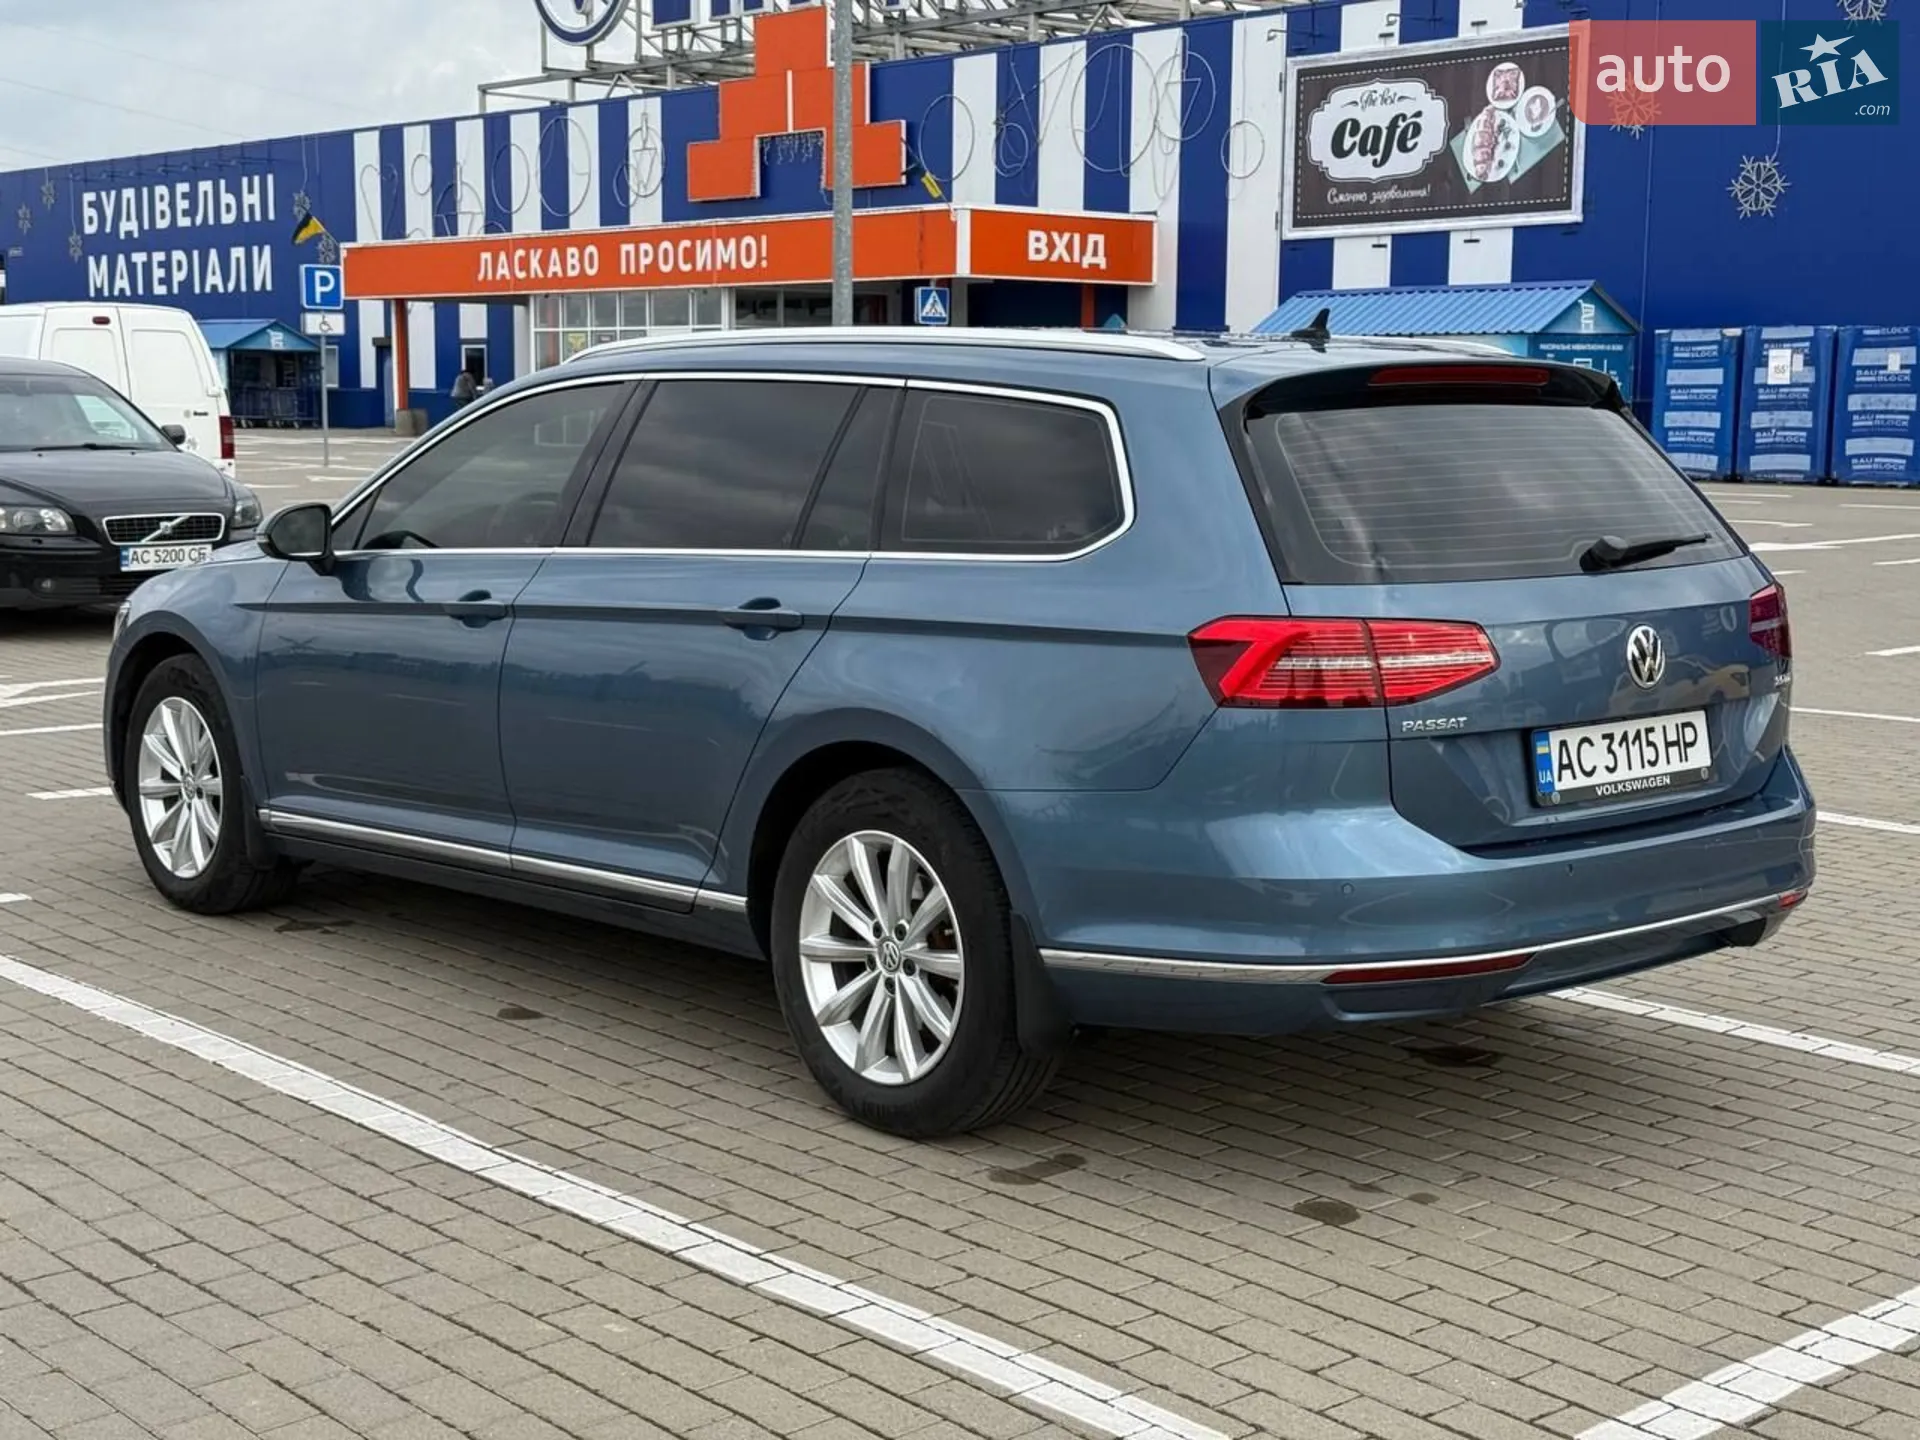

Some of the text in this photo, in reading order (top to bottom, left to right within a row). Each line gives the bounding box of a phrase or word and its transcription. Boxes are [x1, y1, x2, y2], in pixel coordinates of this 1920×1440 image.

[1331, 110, 1423, 168] Café
[82, 173, 276, 240] БУДІВЕЛЬНІ
[477, 235, 769, 281] ЛАСКАВО ПРОСИМО!
[1027, 229, 1107, 270] ВХІД
[87, 244, 273, 297] МАТЕРІАЛИ
[314, 273, 336, 304] P
[130, 549, 150, 564] AC
[153, 547, 186, 564] 5200
[1402, 716, 1468, 733] PASSAT
[1557, 720, 1699, 783] AC 3115 HP
[1538, 770, 1553, 785] UA
[1595, 775, 1672, 797] VOLKSWAGEN
